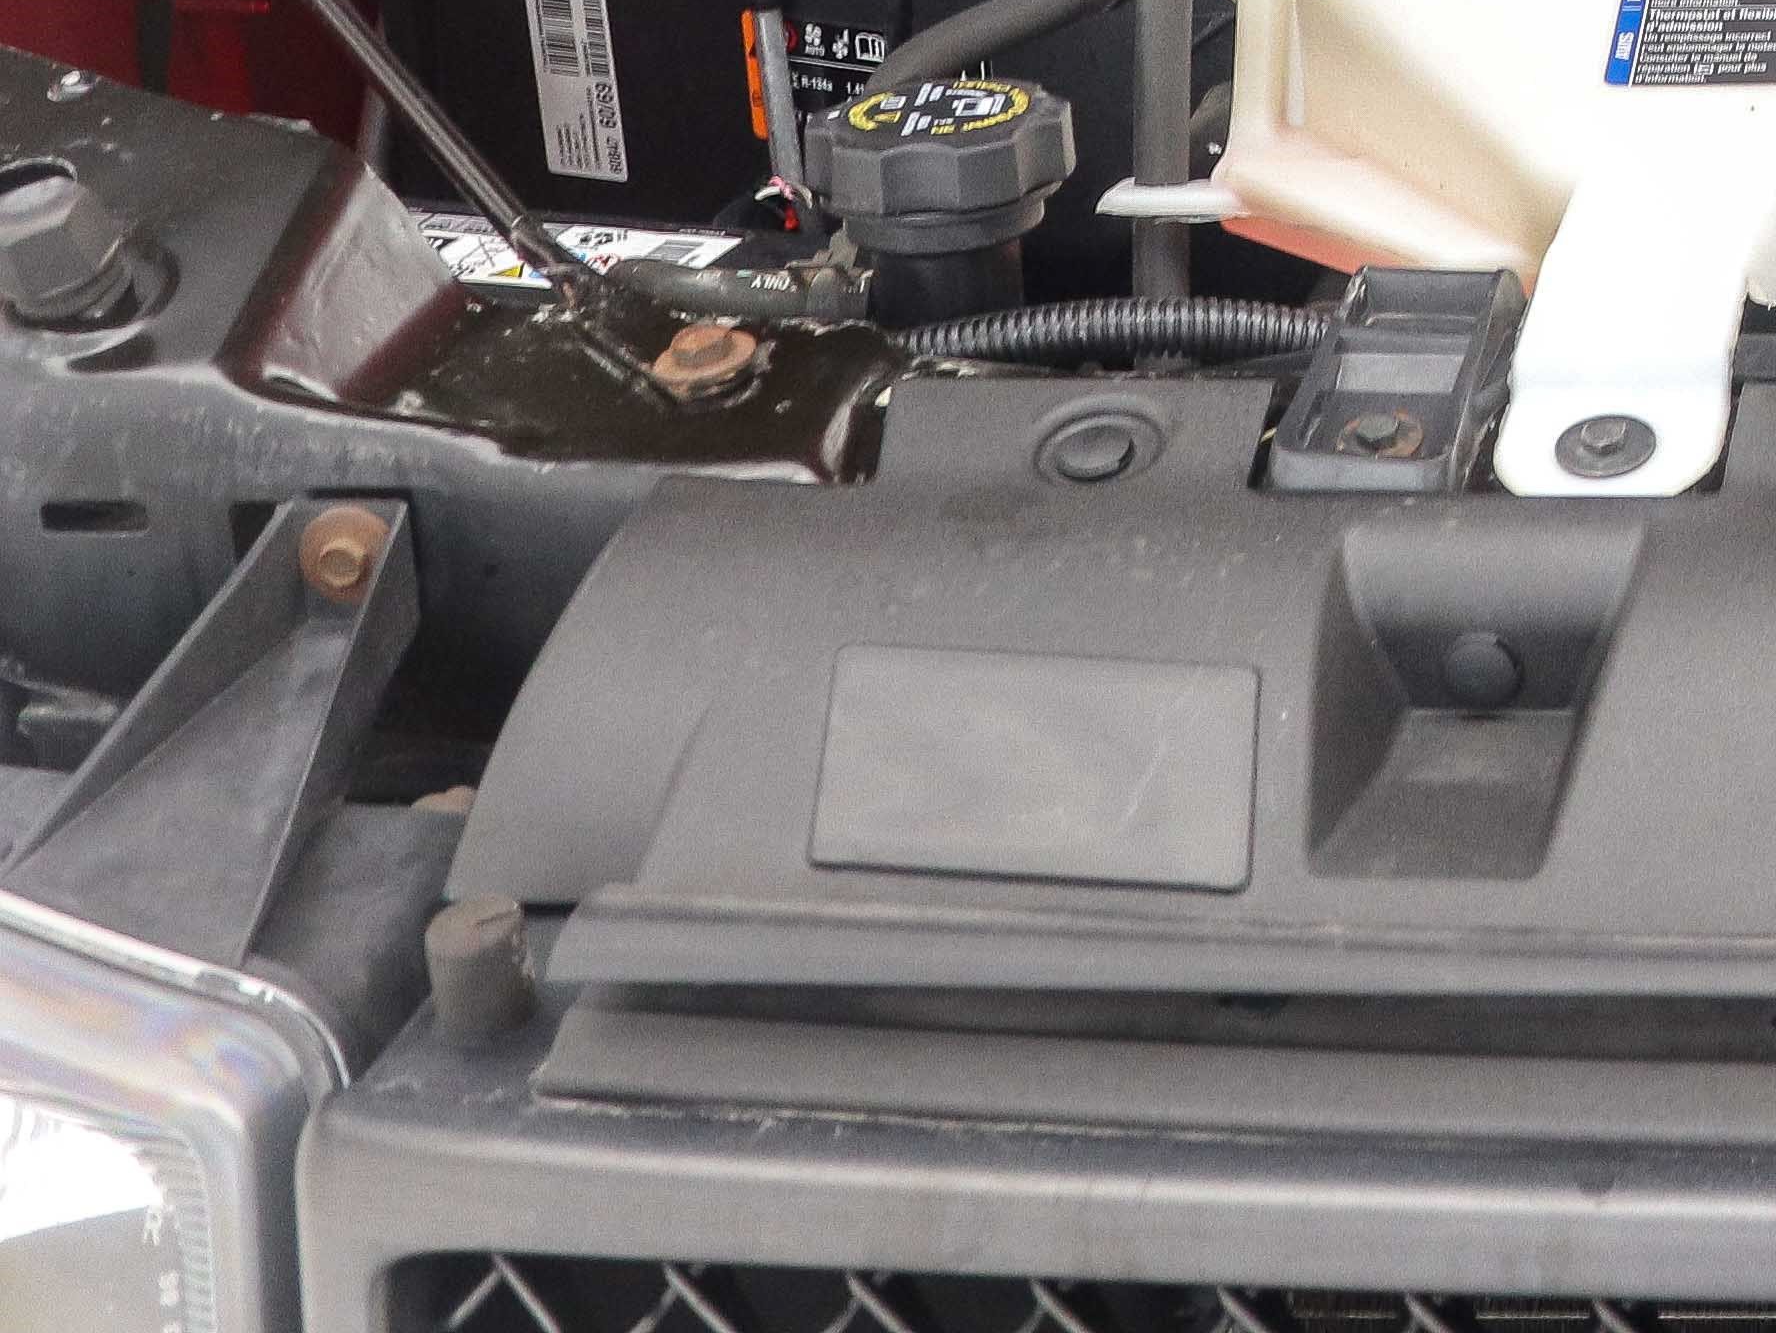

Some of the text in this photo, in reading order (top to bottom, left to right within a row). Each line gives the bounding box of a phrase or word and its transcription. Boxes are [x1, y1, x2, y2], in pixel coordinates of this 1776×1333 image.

[1648, 8, 1721, 21] Thermostat
[1723, 8, 1737, 21] et
[1646, 20, 1723, 32] d'admission
